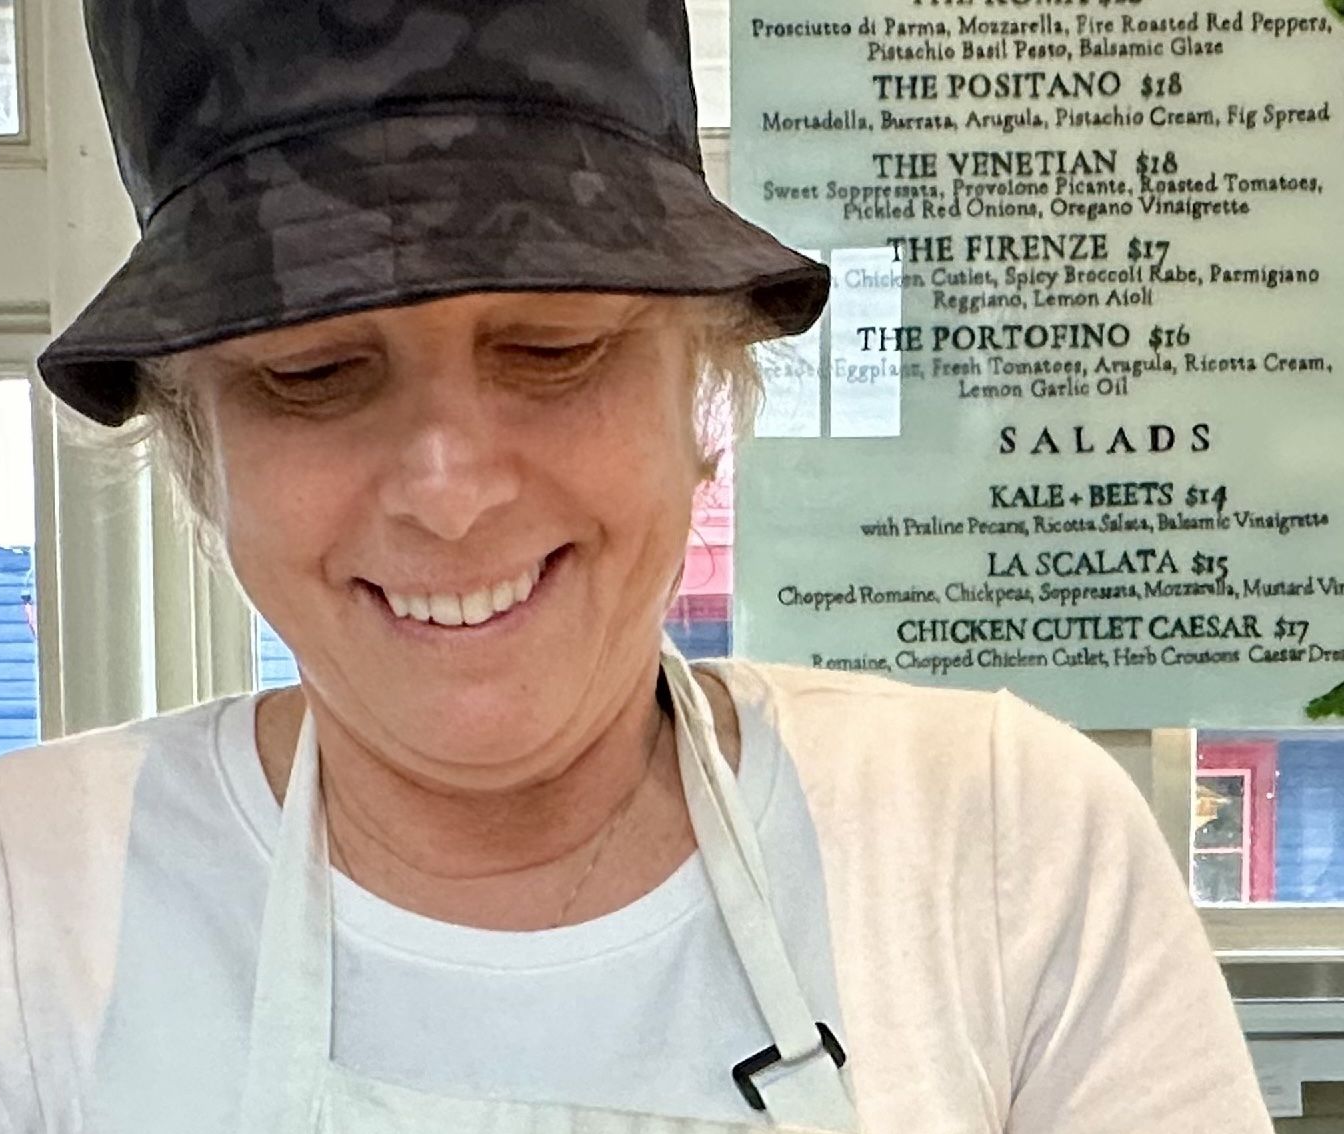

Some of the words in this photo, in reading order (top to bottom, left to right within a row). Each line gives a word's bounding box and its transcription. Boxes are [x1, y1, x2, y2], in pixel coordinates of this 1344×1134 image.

[752, 18, 852, 38] Prosciutto
[858, 16, 876, 35] di
[885, 16, 951, 38] Parma,
[1076, 14, 1114, 34] Fire
[1121, 12, 1198, 33] Roasted
[1206, 11, 1243, 32] Red
[1251, 11, 1333, 37] Peppers,
[867, 41, 955, 61] Pistachio
[962, 39, 1007, 60] Basil
[1014, 40, 1072, 61] Pesto,
[1170, 36, 1224, 55] Glaze
[872, 74, 937, 100] THE
[947, 71, 1121, 99] POSITANO
[1141, 72, 1182, 99] $18
[762, 109, 874, 132] Mortadella,
[965, 108, 1049, 133] Arugula,
[1056, 107, 1144, 127] Pistachio
[1227, 106, 1257, 130] Fig
[1263, 102, 1330, 130] Spread
[872, 153, 937, 179] THE
[947, 149, 1117, 177] VENETIAN
[1136, 148, 1178, 176] $18
[763, 181, 818, 201] Sweet
[953, 178, 1049, 197] Provolone
[1140, 172, 1217, 194] Roasted
[1223, 173, 1323, 194] Tomatoes,
[843, 199, 915, 220] Pickled
[922, 198, 961, 219] Red
[1050, 198, 1133, 220] Oregano
[1138, 196, 1250, 220] Vinaigrette
[887, 235, 954, 262] THE
[965, 234, 1108, 261] FIRENZE
[1127, 236, 1170, 267] $17
[844, 267, 925, 289] Chicken
[1005, 266, 1058, 290] Spicy
[1148, 265, 1203, 287] Rabe,
[1210, 264, 1320, 288] Parmigiano
[933, 289, 1028, 314] Reggiano,
[1034, 289, 1099, 307] Lemon
[857, 326, 923, 351] THE
[932, 324, 1130, 351] PORTOFINO
[1148, 324, 1190, 352] $16
[932, 356, 981, 377] Fresh
[988, 355, 1087, 376] Tomatoes,
[1094, 354, 1177, 378] Arugula,
[1185, 353, 1256, 372] Ricotta
[958, 379, 1022, 398] Lemon
[1031, 378, 1089, 398] Garlic
[1097, 376, 1128, 396] Oil
[989, 484, 1065, 508] KALE
[1088, 481, 1174, 507] BEETS
[1185, 484, 1228, 511] $14
[860, 517, 899, 537] with
[903, 516, 963, 536] Praline
[968, 516, 1030, 537] Pecans,
[1033, 515, 1096, 534] Ricotta
[1233, 511, 1329, 535] Vinaigrette
[988, 552, 1028, 577] LA
[1035, 549, 1178, 577] SCALATA
[1191, 550, 1229, 579] $15
[778, 584, 855, 611] Chopped
[1243, 576, 1312, 598] Mustard
[897, 618, 1028, 643] CHICKEN
[1033, 616, 1143, 642] CUTLET
[1149, 614, 1262, 640] CAESAR
[1274, 617, 1310, 645] $17
[896, 650, 973, 675] Chopped
[977, 648, 1048, 668] Chicken
[1114, 646, 1156, 666] Herb
